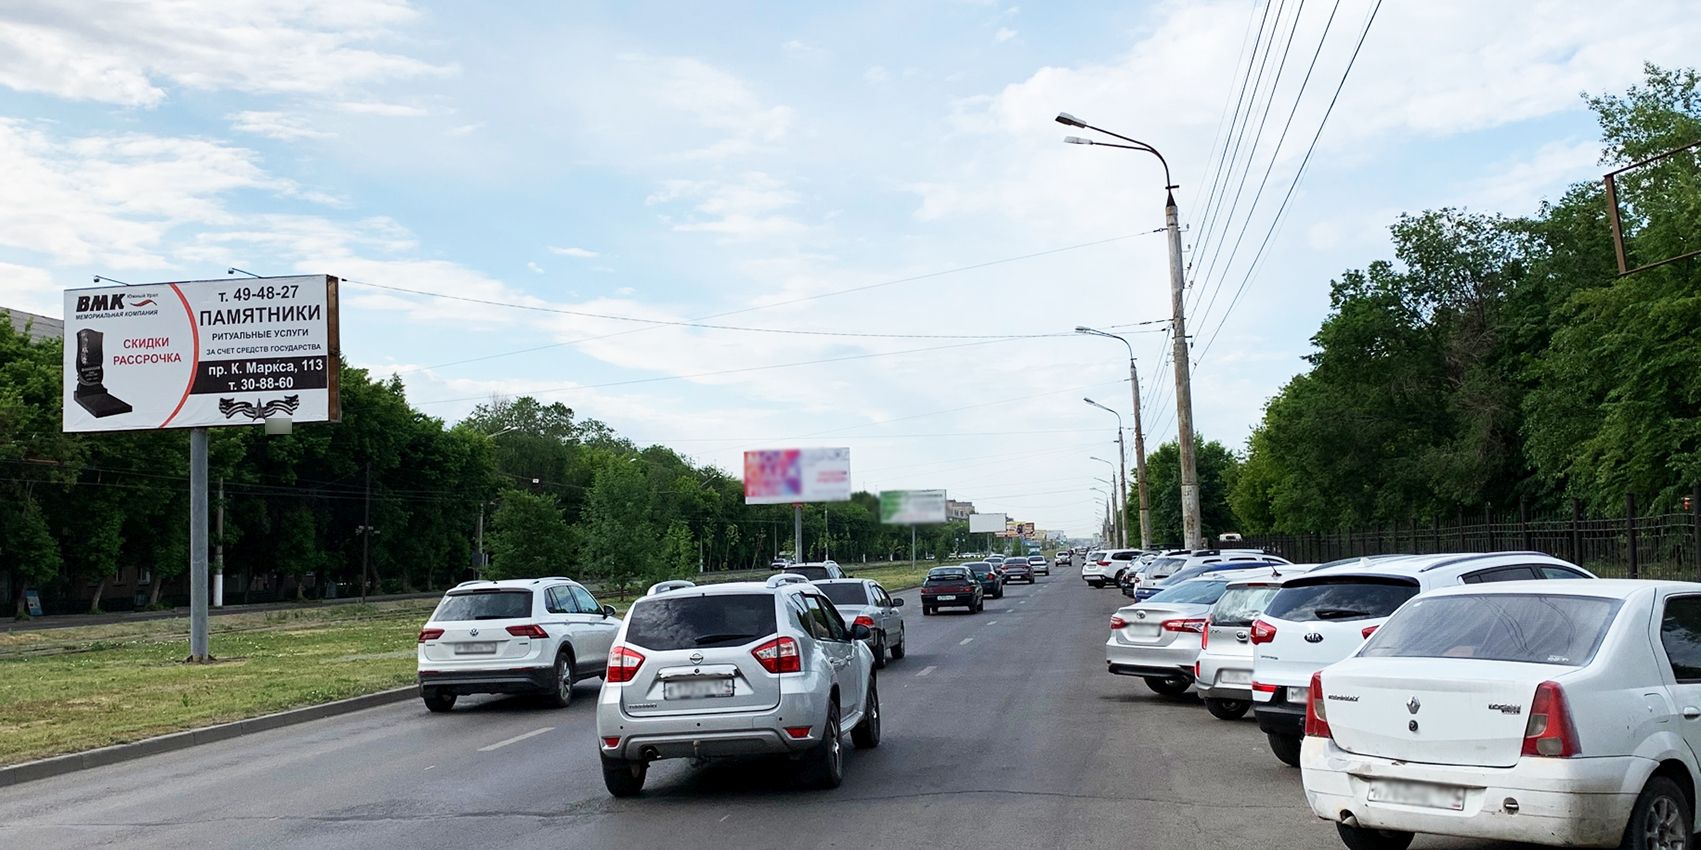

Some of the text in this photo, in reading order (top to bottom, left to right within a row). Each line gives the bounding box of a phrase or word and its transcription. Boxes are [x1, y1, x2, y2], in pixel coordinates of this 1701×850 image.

[218, 285, 299, 302] т. 49-48-27
[76, 293, 126, 312] ВМК
[75, 312, 124, 320] МЕМОРИАЛЬНАЯ
[200, 304, 320, 326] ПАМЯТНИКИ
[212, 328, 309, 341] РИТУАЛЬНЫЕ УСЛУГИ
[123, 337, 169, 349] СКИДКИ
[206, 343, 322, 356] ЗА СЧЕТ СРЕДСТВ ГОСУДАРСТВА
[113, 353, 182, 365] РАССРОЧКА
[208, 366, 228, 378] пр.
[231, 362, 243, 375] К.
[301, 358, 324, 371] 113
[228, 376, 294, 391] т. 30-88-60
